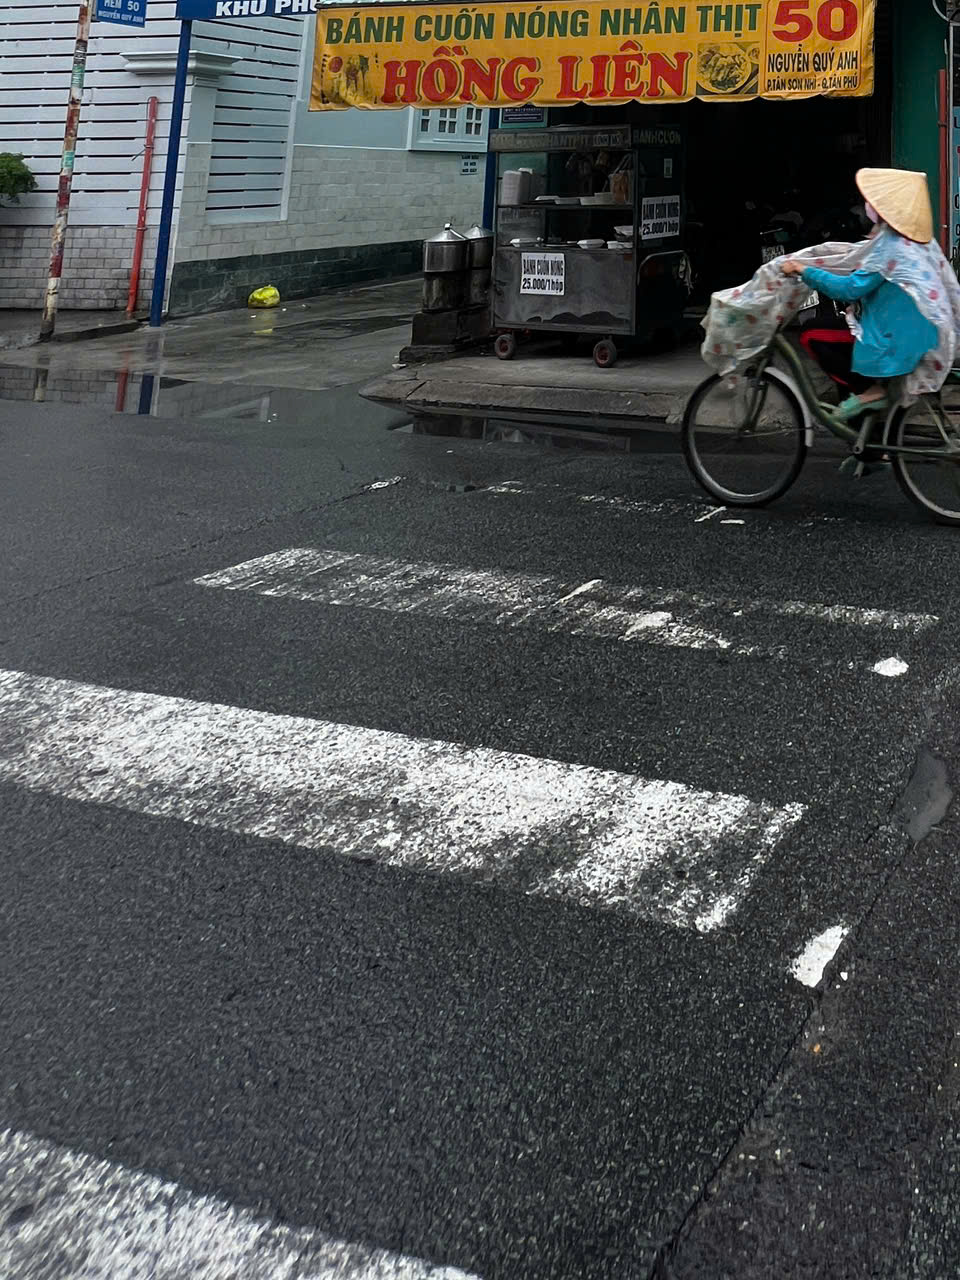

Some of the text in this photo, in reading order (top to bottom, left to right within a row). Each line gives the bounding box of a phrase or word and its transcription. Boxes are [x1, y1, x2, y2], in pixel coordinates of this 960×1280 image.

[127, 0, 140, 12] 50
[215, 0, 268, 17] KHU
[326, 2, 762, 44] BÁNH CUỐN NÓNG NHÂN THỊT
[768, 44, 858, 72] NGUYỄN QUÝ ANH
[381, 39, 694, 103] HỒNG LIÊN
[768, 76, 786, 91] P.TÂN
[822, 74, 841, 89] Q.TÂN
[843, 73, 858, 88] PHÚ
